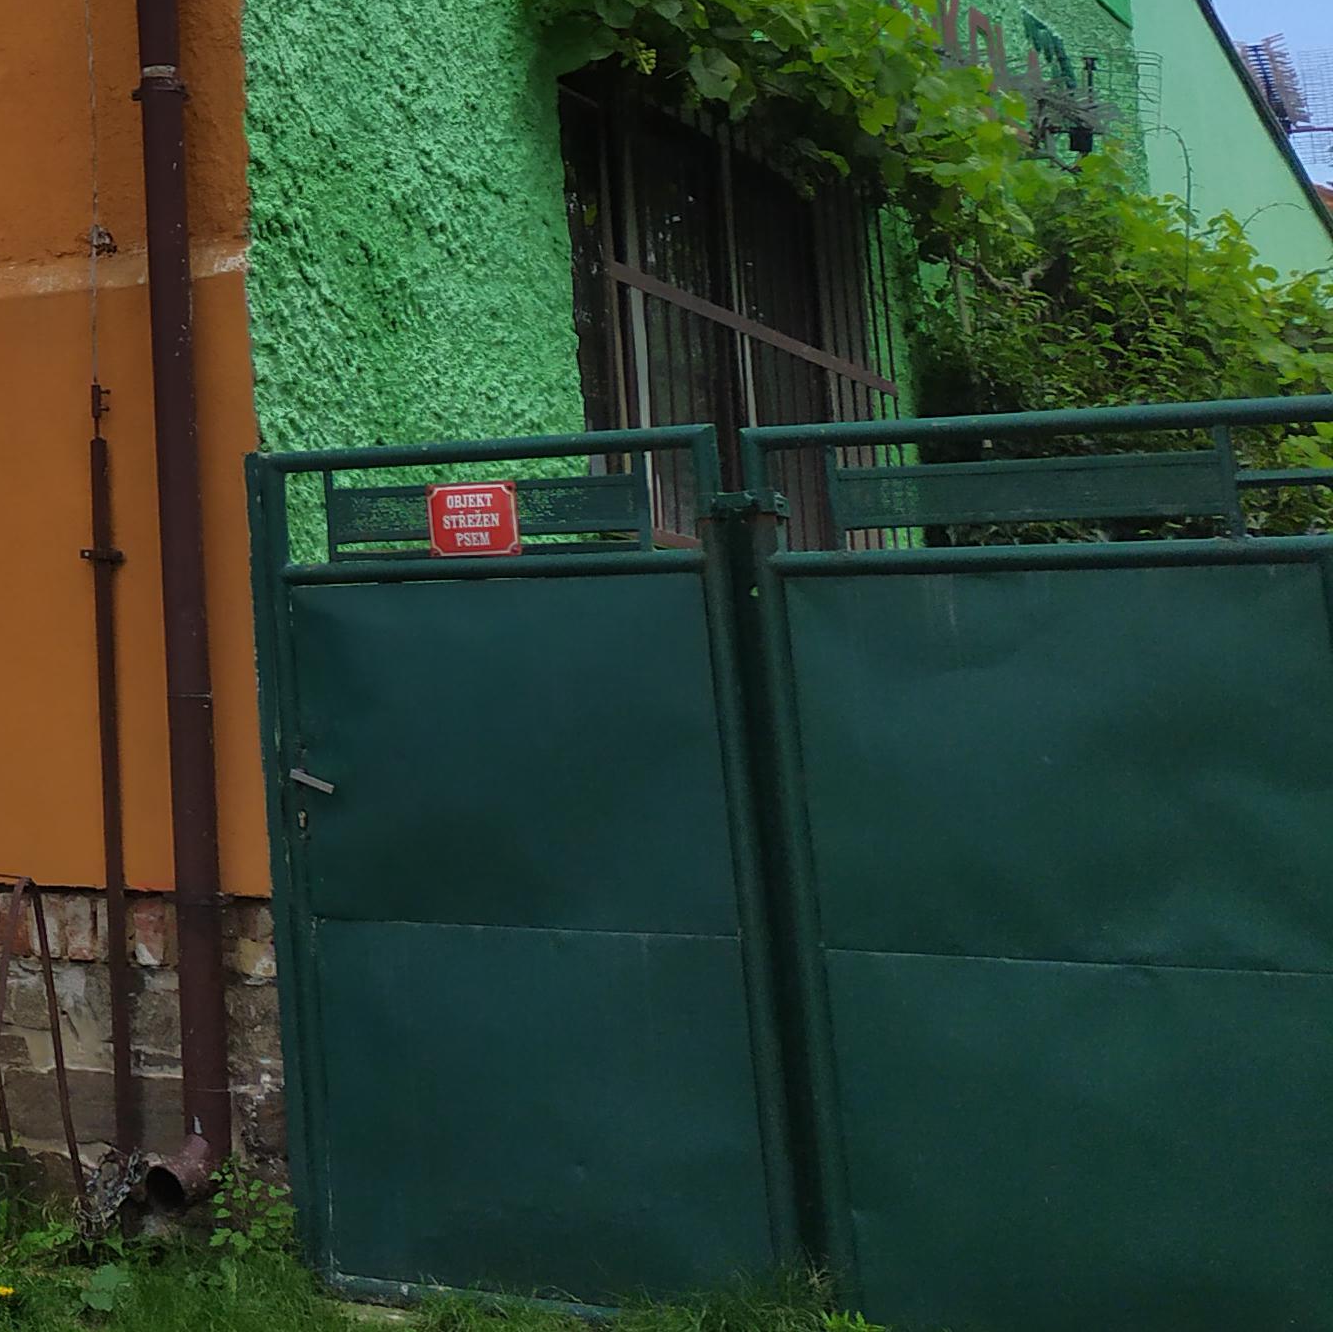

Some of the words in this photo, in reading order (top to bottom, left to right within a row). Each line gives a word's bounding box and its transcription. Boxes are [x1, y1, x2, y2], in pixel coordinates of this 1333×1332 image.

[446, 493, 493, 509] OBJEKT
[442, 509, 500, 530] STŘEŽEN
[455, 531, 491, 547] PSEM
